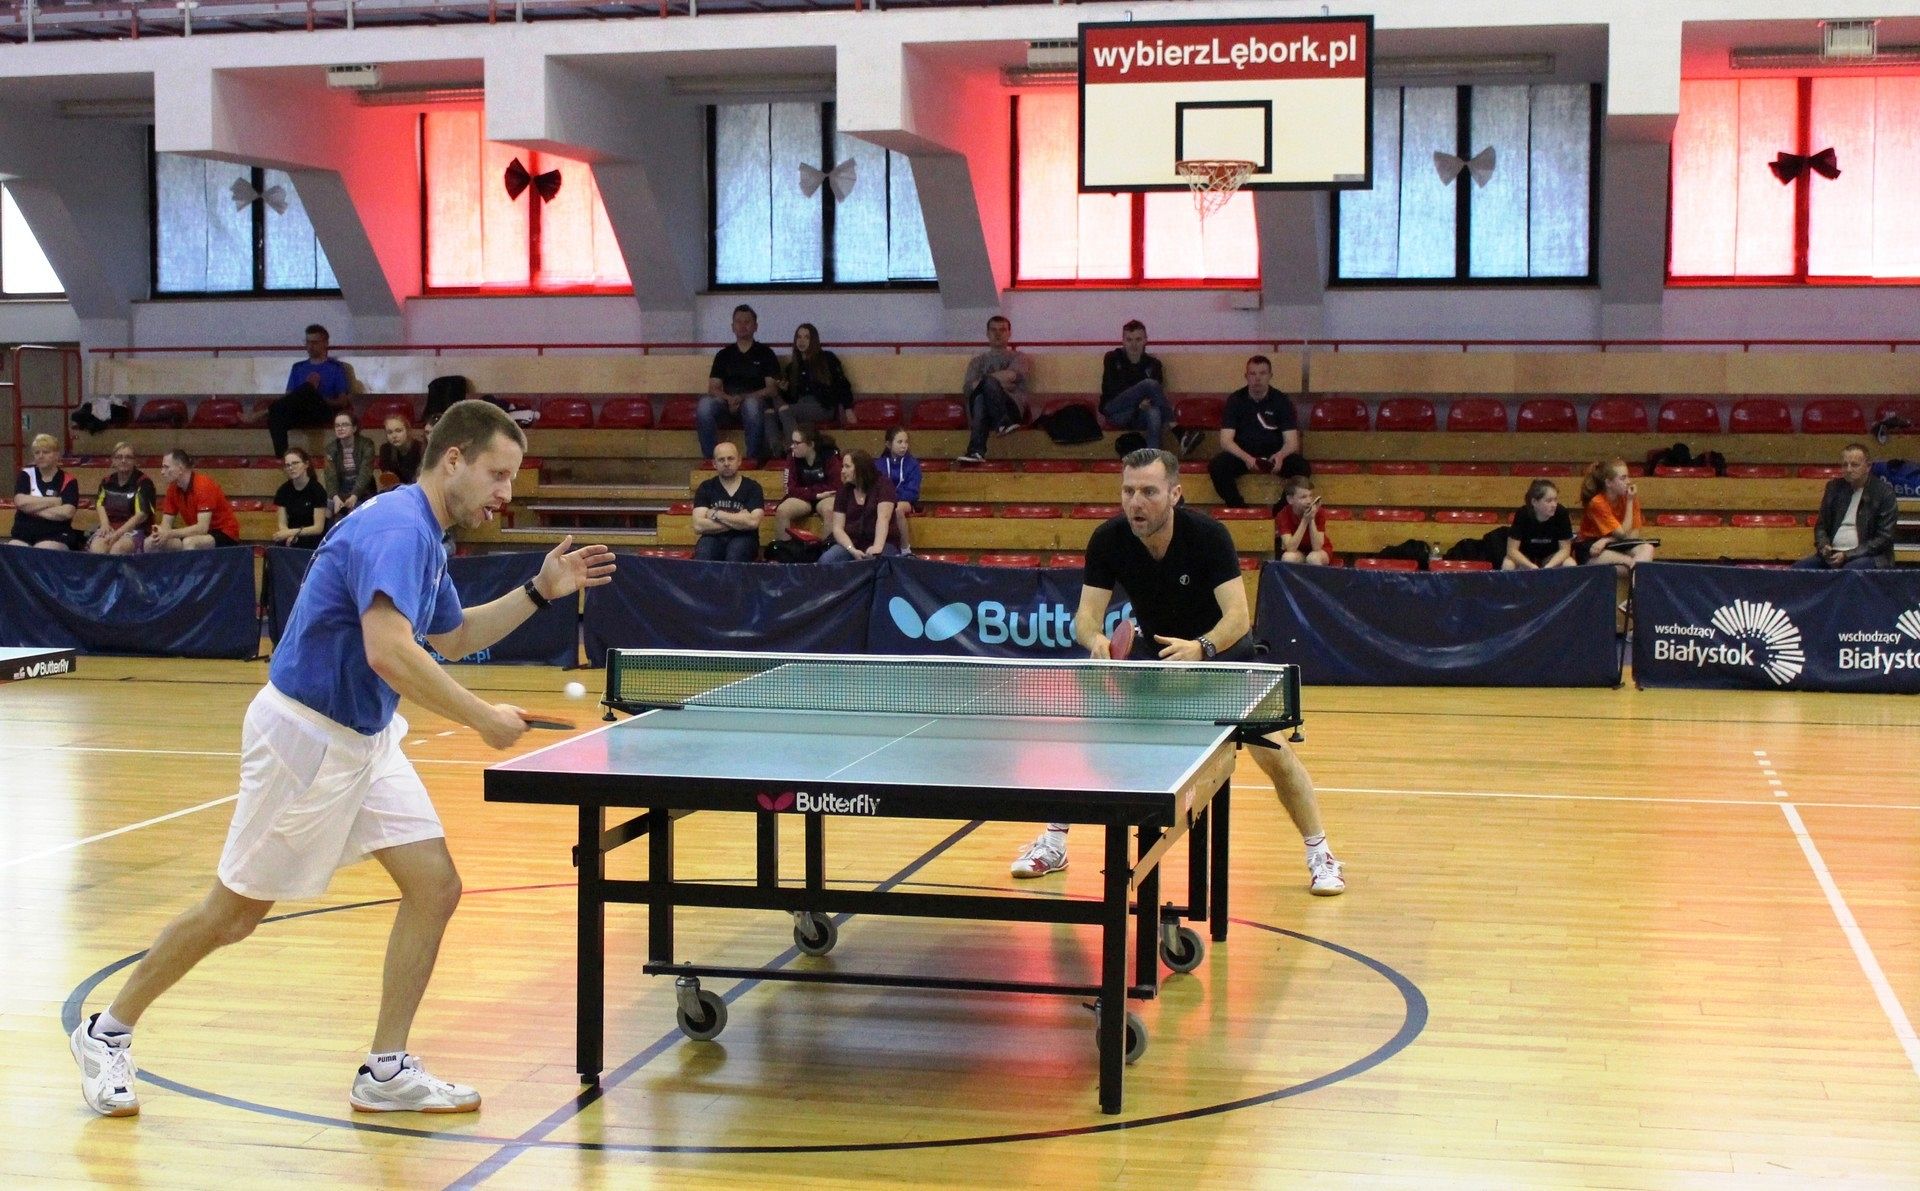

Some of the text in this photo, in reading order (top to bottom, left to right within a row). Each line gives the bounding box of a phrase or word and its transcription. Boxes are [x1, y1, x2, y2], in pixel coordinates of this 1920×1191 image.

[1093, 34, 1357, 74] wybierzLębork.pl
[1654, 622, 1716, 639] wschodzący
[1838, 630, 1901, 645] wschodzący
[1654, 638, 1755, 667] Białystok
[40, 658, 70, 674] Butterfly
[796, 791, 881, 816] Butterfly
[377, 1054, 397, 1063] PUMA
